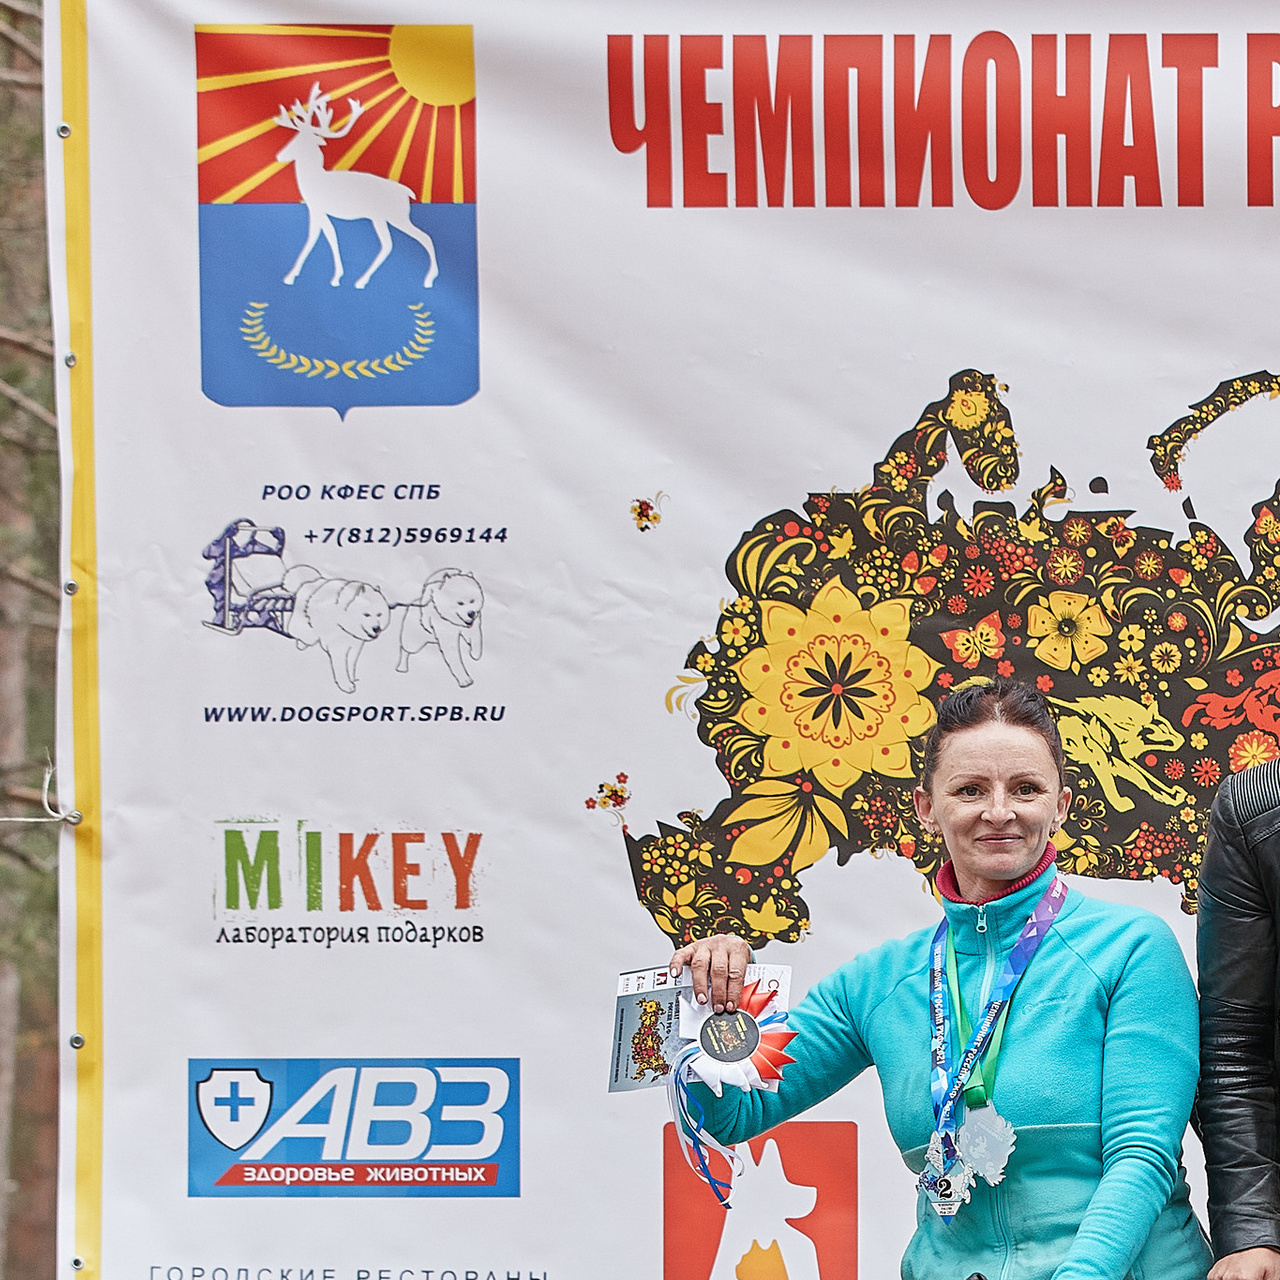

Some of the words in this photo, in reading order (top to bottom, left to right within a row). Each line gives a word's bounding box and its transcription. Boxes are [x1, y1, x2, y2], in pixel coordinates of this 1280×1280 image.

[606, 31, 1219, 209] ЧЕМПИОНАТ
[261, 484, 312, 501] РОО
[320, 484, 386, 501] КФЕС
[393, 484, 442, 501] СПБ
[303, 526, 509, 545] +7(812)5969144
[203, 706, 507, 723] WWW.DOGSPORT.SPB.RU
[222, 827, 484, 913] MIKEY
[215, 922, 370, 948] лаборатория
[376, 921, 485, 949] подарков
[240, 1066, 508, 1161] АВЗ
[243, 1167, 354, 1185] здоровье
[366, 1167, 486, 1182] животных
[938, 1178, 953, 1199] 2
